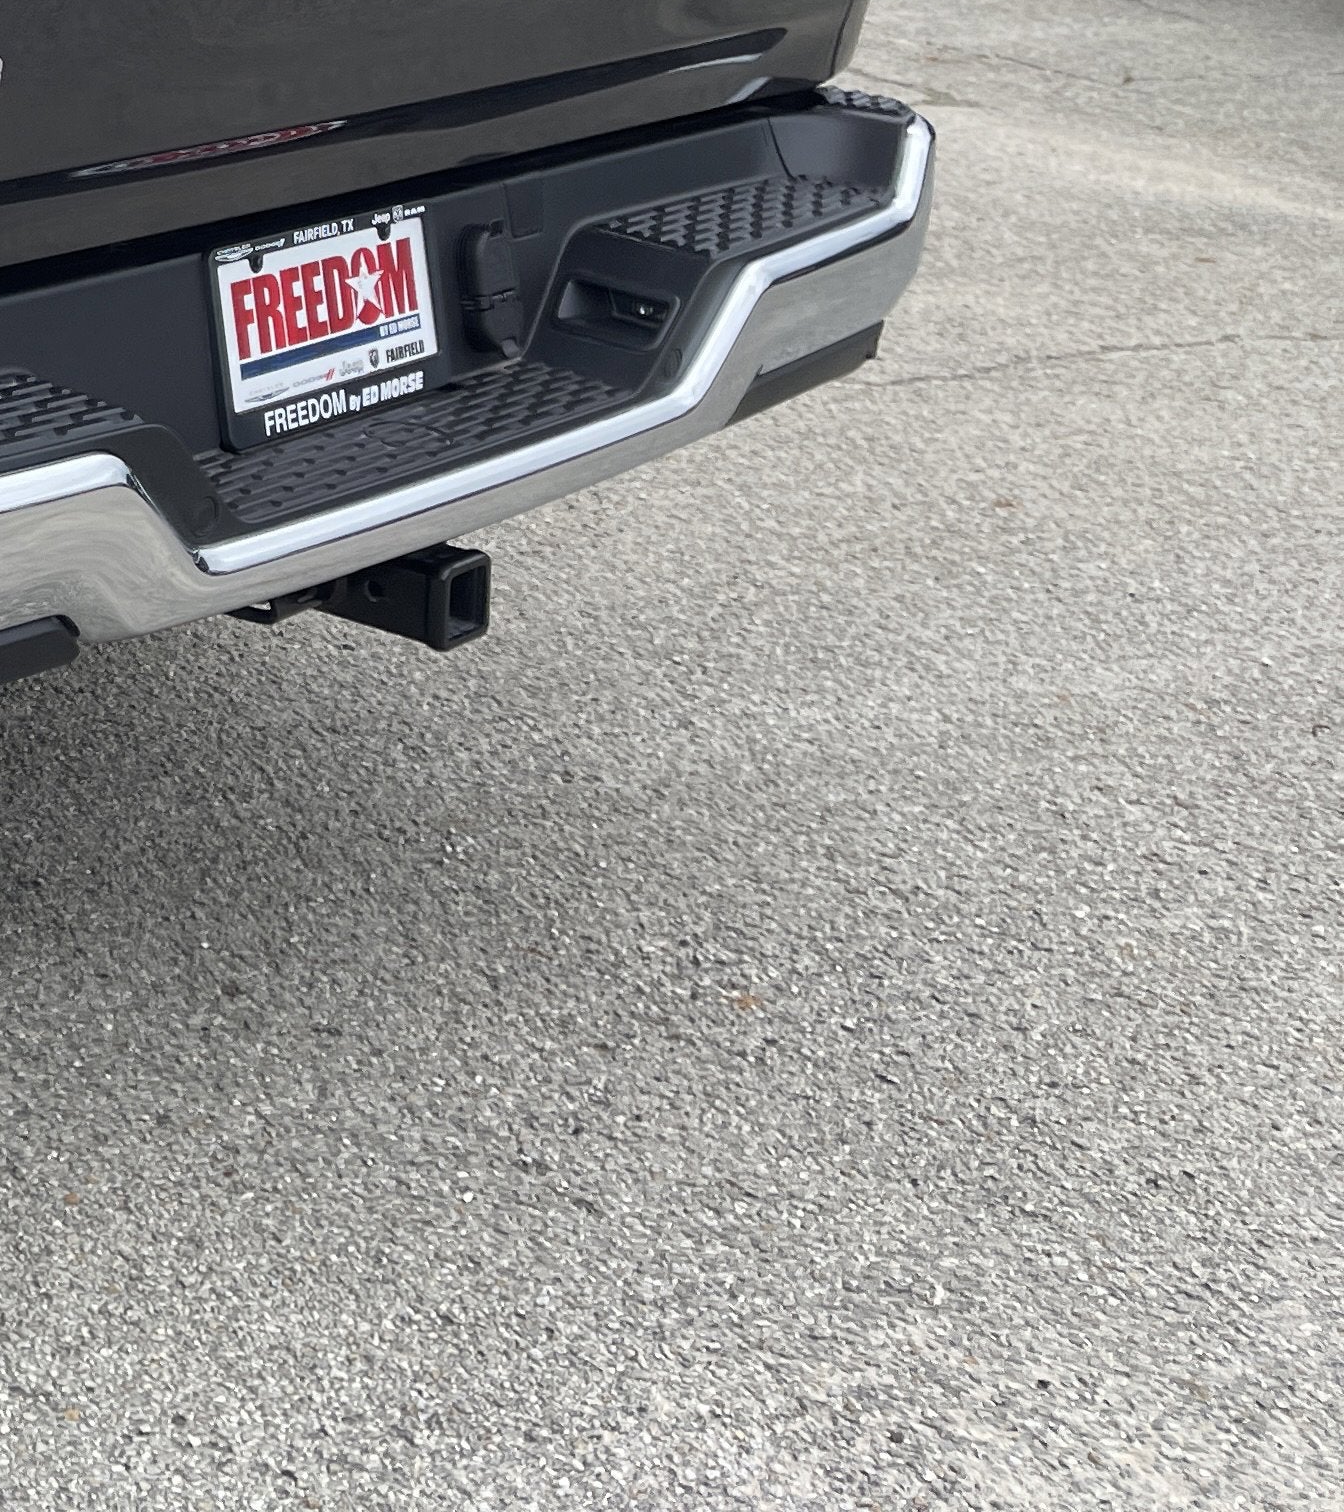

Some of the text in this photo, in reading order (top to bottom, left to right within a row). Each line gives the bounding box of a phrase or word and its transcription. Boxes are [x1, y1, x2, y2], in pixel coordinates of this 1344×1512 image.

[341, 219, 354, 232] TX
[372, 212, 391, 225] Jeep
[230, 237, 419, 361] FREEDOM
[385, 340, 424, 363] FAIRFIELD
[264, 389, 347, 436] FREEDOM
[362, 384, 379, 407] ED
[380, 370, 424, 401] MORSE
